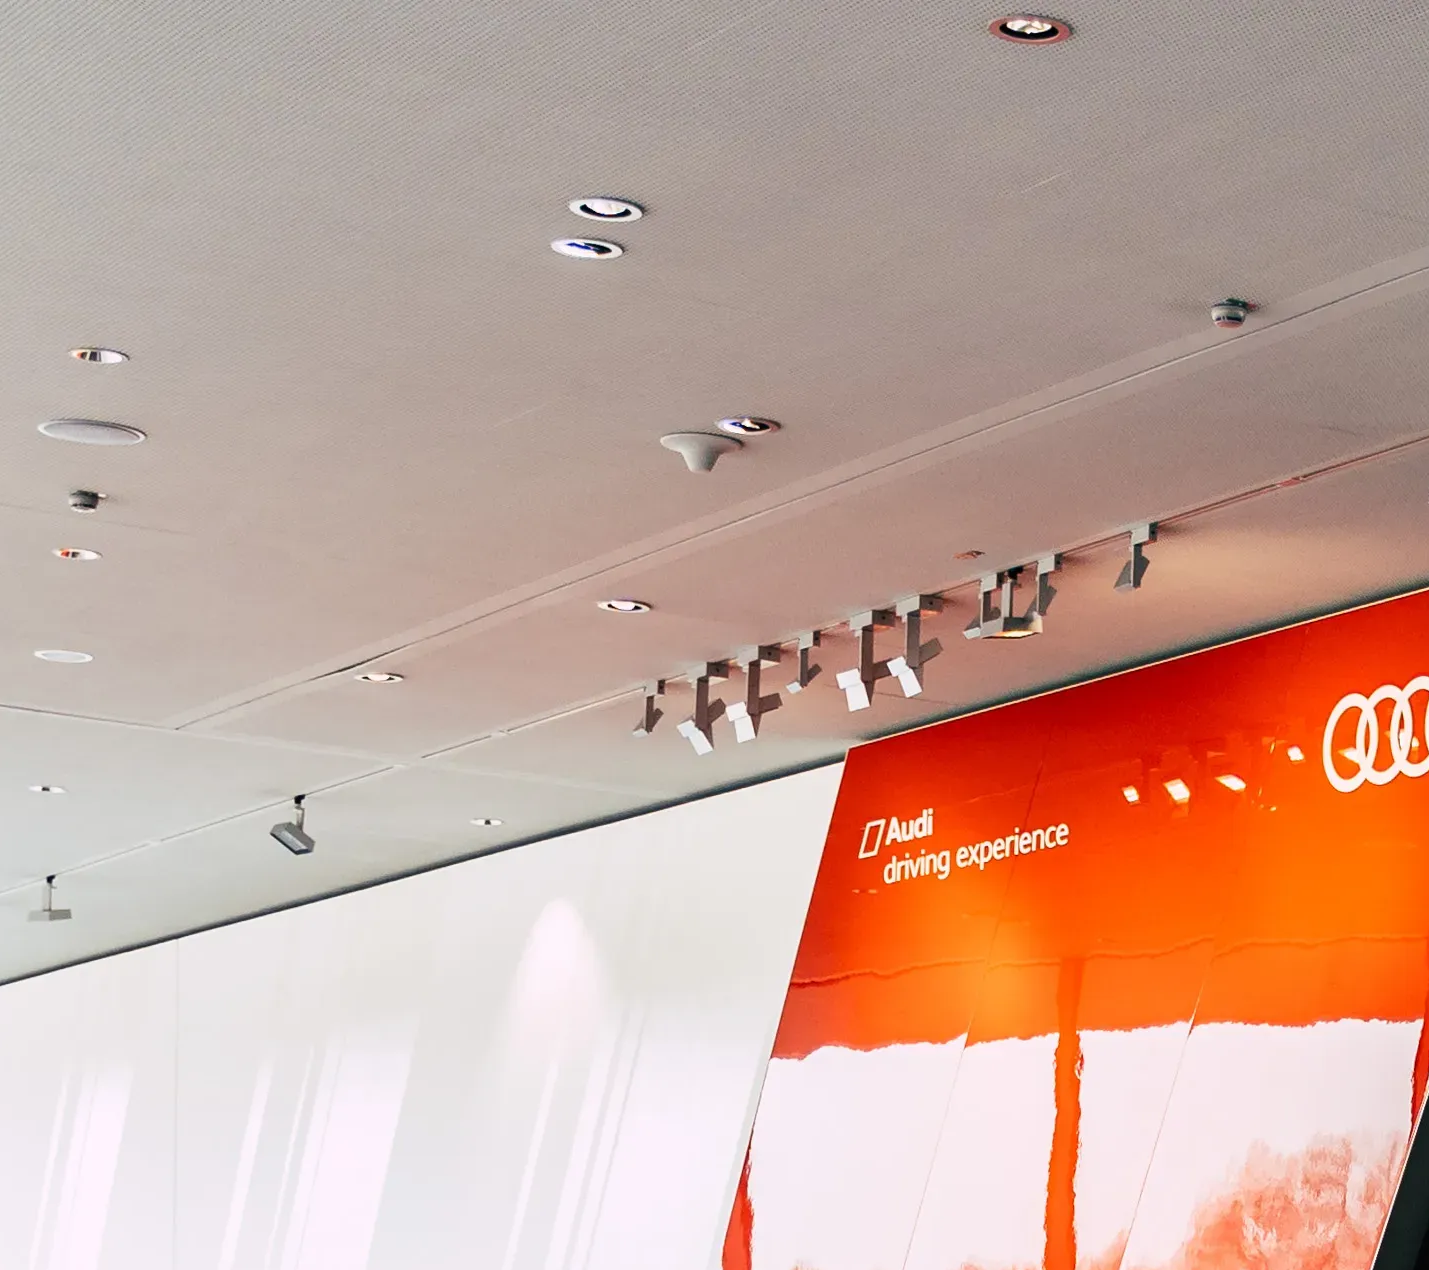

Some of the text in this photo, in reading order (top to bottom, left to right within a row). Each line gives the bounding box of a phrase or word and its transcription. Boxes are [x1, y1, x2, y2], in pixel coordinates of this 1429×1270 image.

[884, 807, 934, 846] Audi
[883, 822, 1070, 885] driving experience
